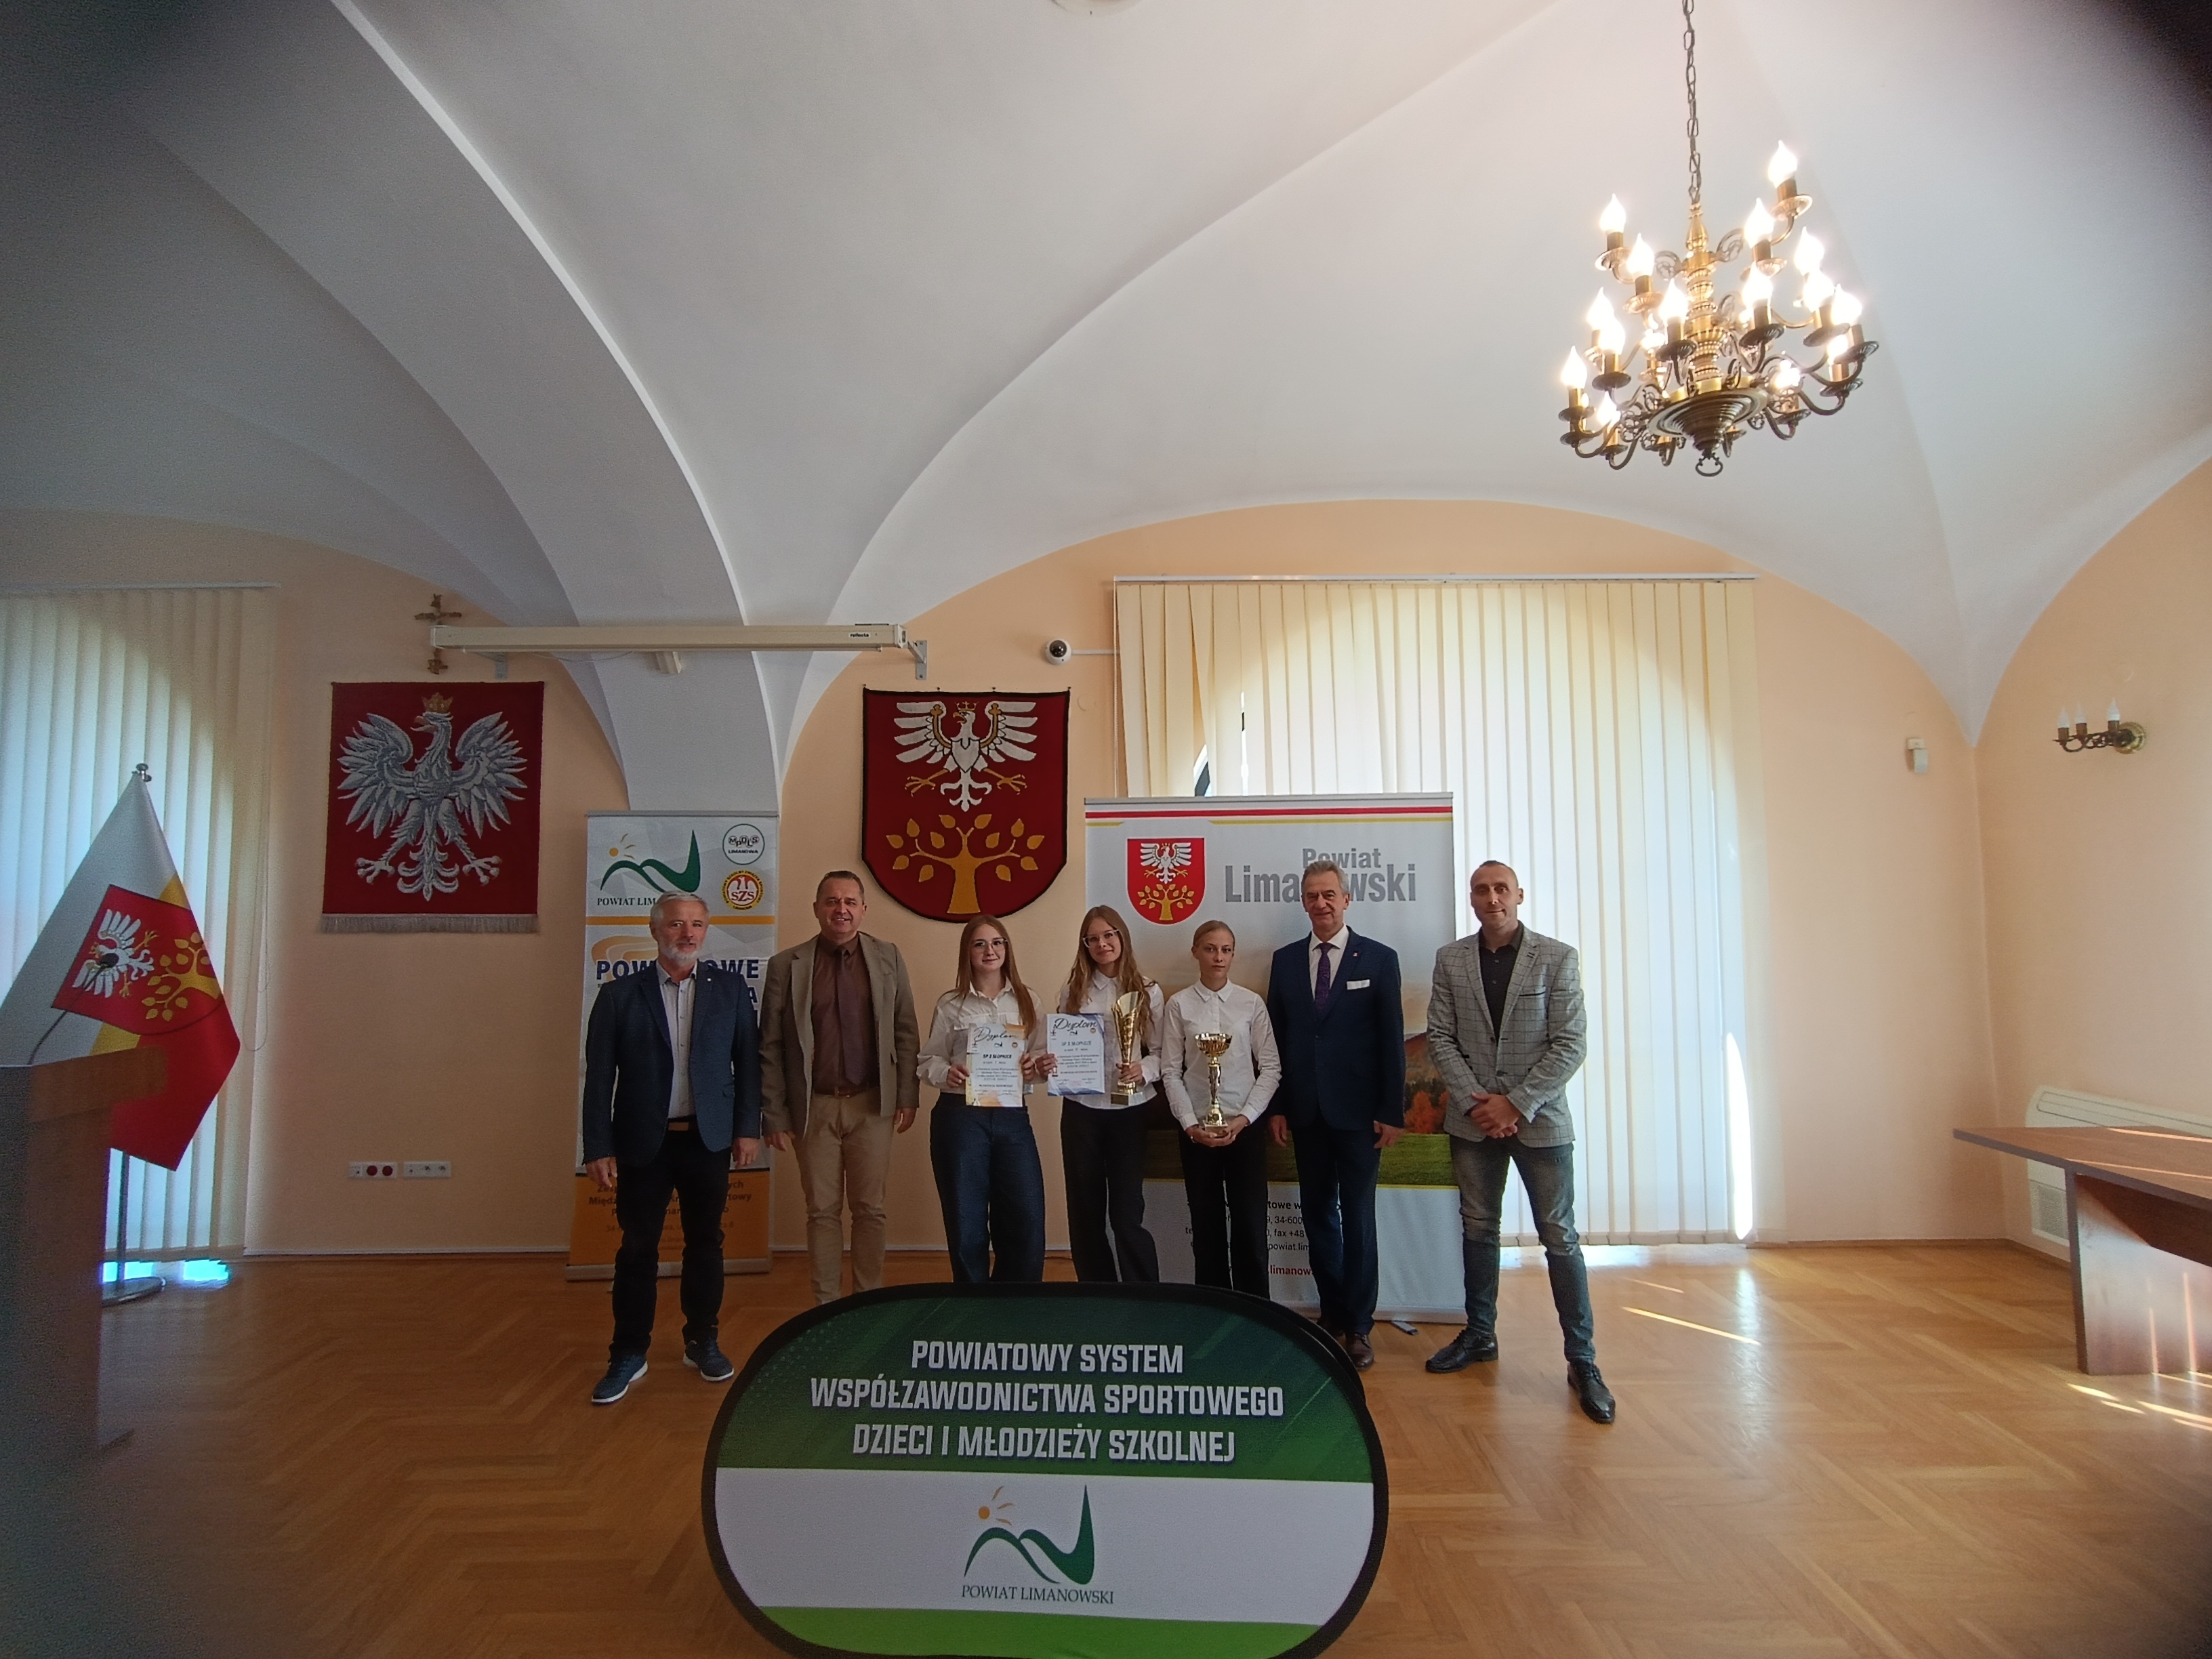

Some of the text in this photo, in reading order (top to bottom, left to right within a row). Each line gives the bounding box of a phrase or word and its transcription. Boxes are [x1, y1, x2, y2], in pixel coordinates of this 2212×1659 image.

[1225, 863, 1416, 903] Limawski
[597, 897, 657, 906] POWIAT LIM
[731, 891, 755, 902] SZS
[1054, 1017, 1099, 1031] Dyplom
[1274, 1229, 1286, 1237] fax
[912, 1340, 1183, 1373] POWIATOWY SYSTEM
[811, 1374, 1284, 1416] WSPÓŁZAWODNICTWA SPORTOWEGO
[853, 1423, 1235, 1462] DZIECI I MŁODZIEŻY SZKOLNEJ
[961, 1584, 1114, 1604] POWIAT LIMANOWSKI
